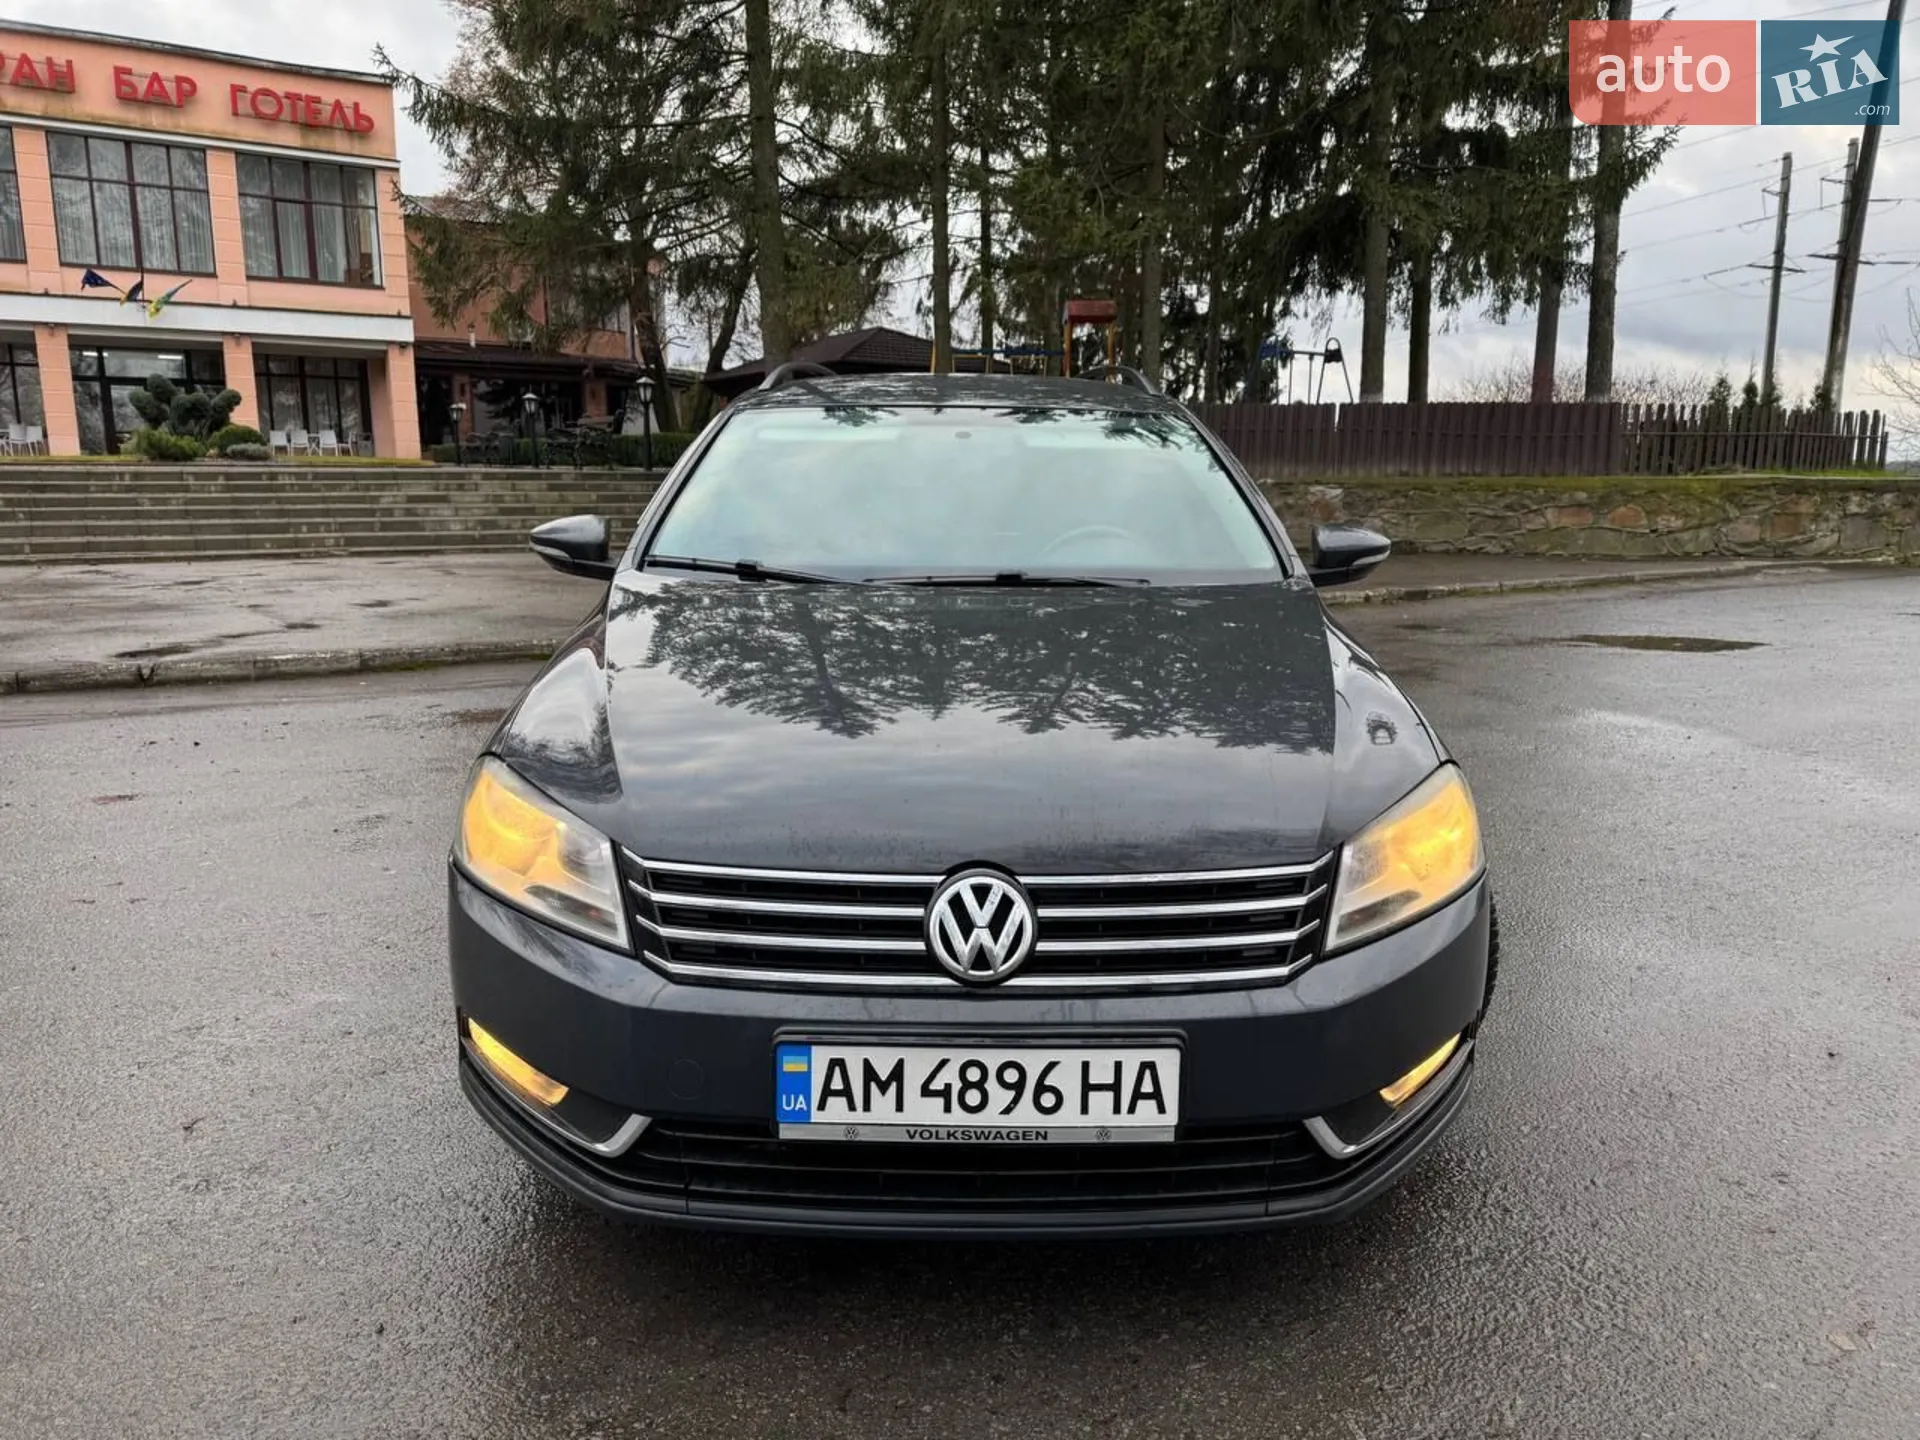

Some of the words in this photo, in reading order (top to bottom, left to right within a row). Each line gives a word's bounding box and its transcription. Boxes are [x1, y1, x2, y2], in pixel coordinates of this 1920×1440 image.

[113, 65, 198, 109] БАР
[229, 83, 375, 134] ГОТЕЛЬ
[782, 1093, 808, 1111] UA
[816, 1057, 905, 1113] AM
[920, 1058, 1064, 1116] 4896
[1080, 1060, 1167, 1116] HA
[905, 1128, 1049, 1142] VOLKSWAGEN
